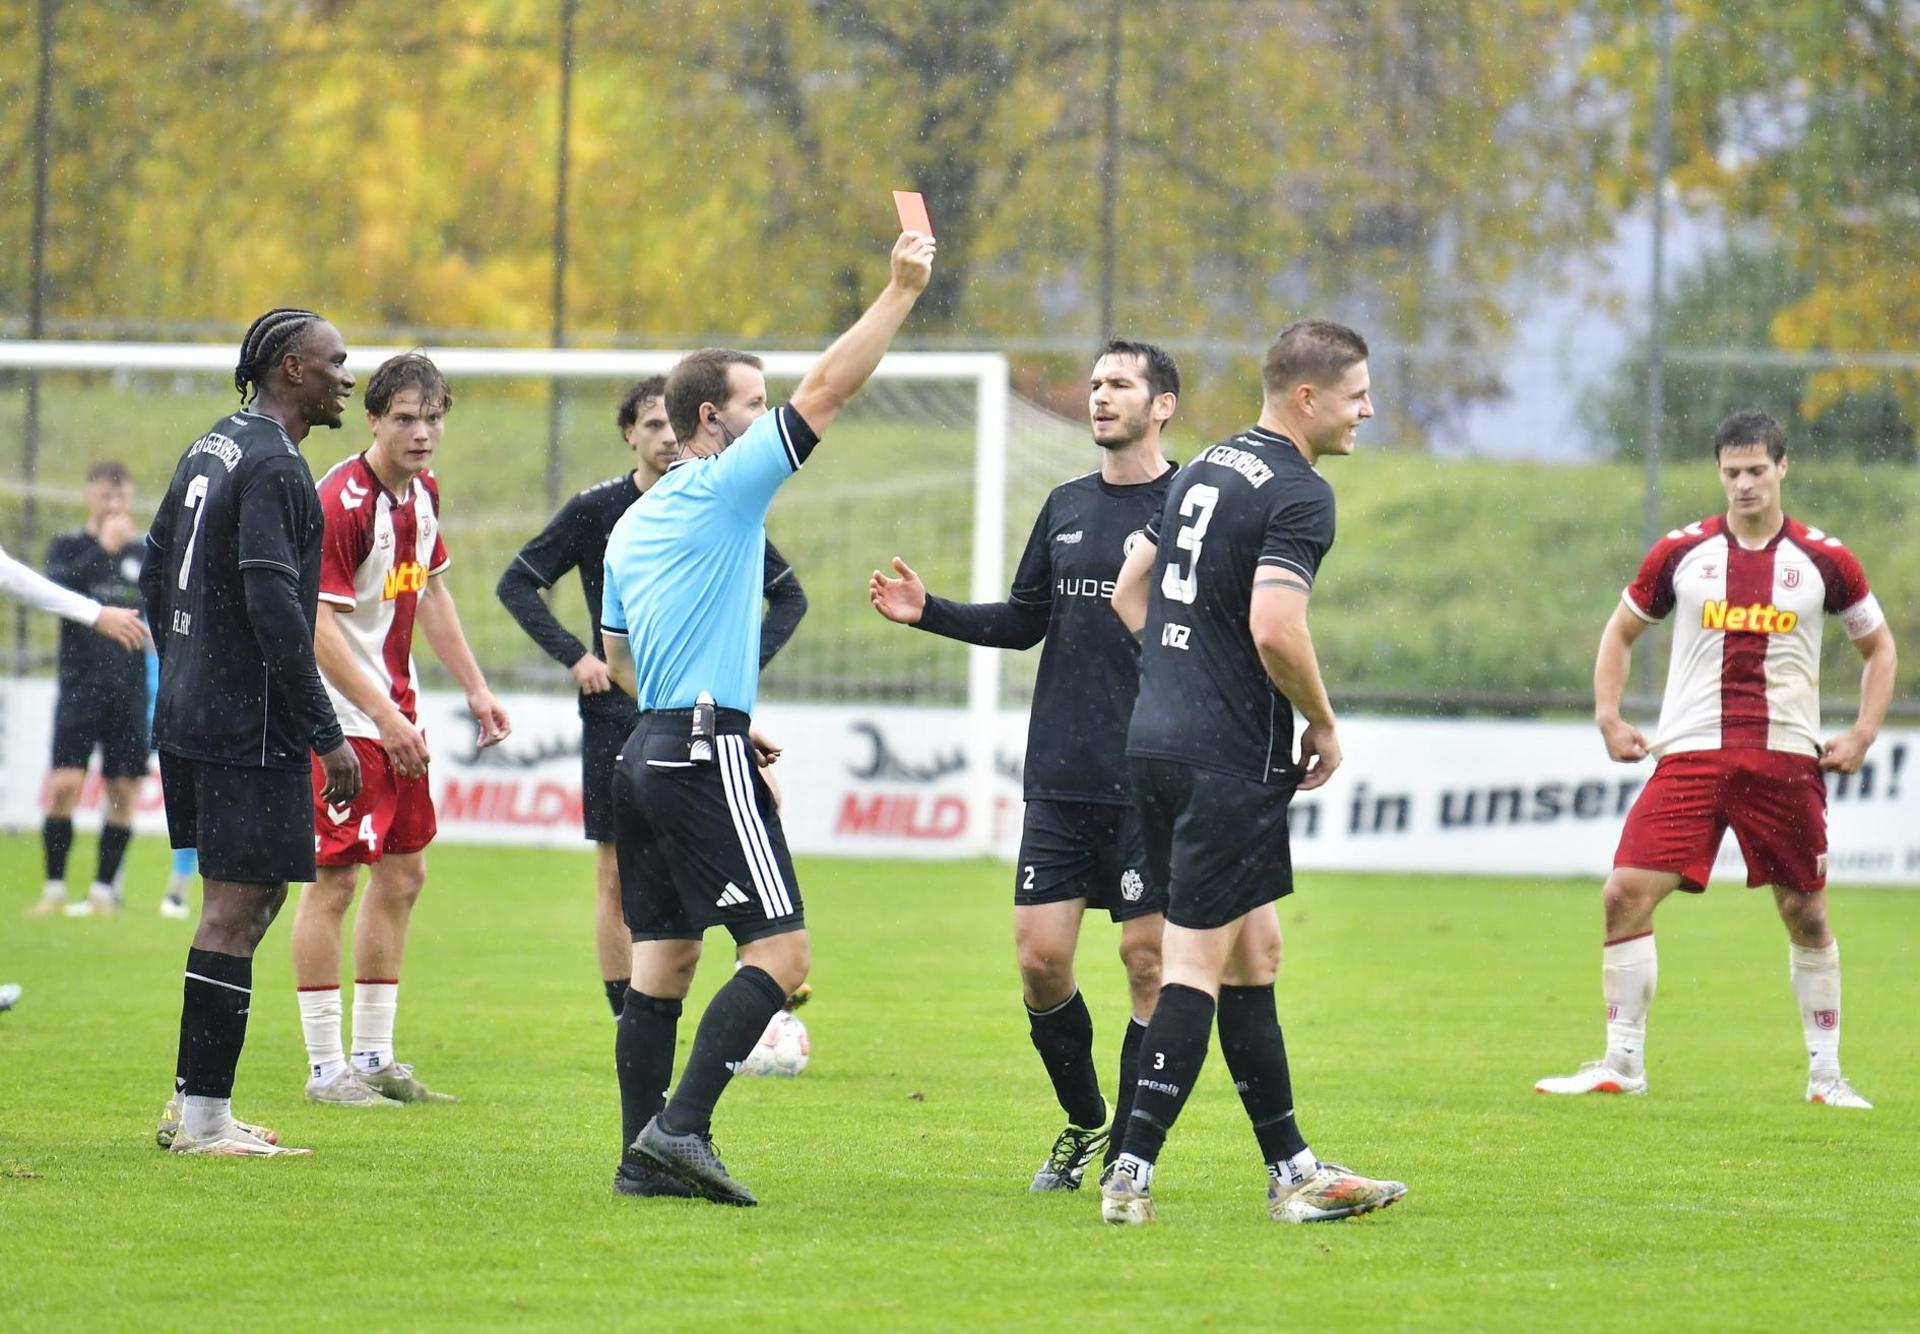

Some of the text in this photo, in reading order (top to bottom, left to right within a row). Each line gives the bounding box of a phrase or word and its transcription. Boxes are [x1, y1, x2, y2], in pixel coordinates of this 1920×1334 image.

[178, 474, 209, 591] 7
[1161, 483, 1220, 605] 3
[1702, 600, 1798, 634] Netto
[358, 814, 378, 852] 4
[1023, 866, 1035, 890] 2
[1153, 1052, 1165, 1070] 3
